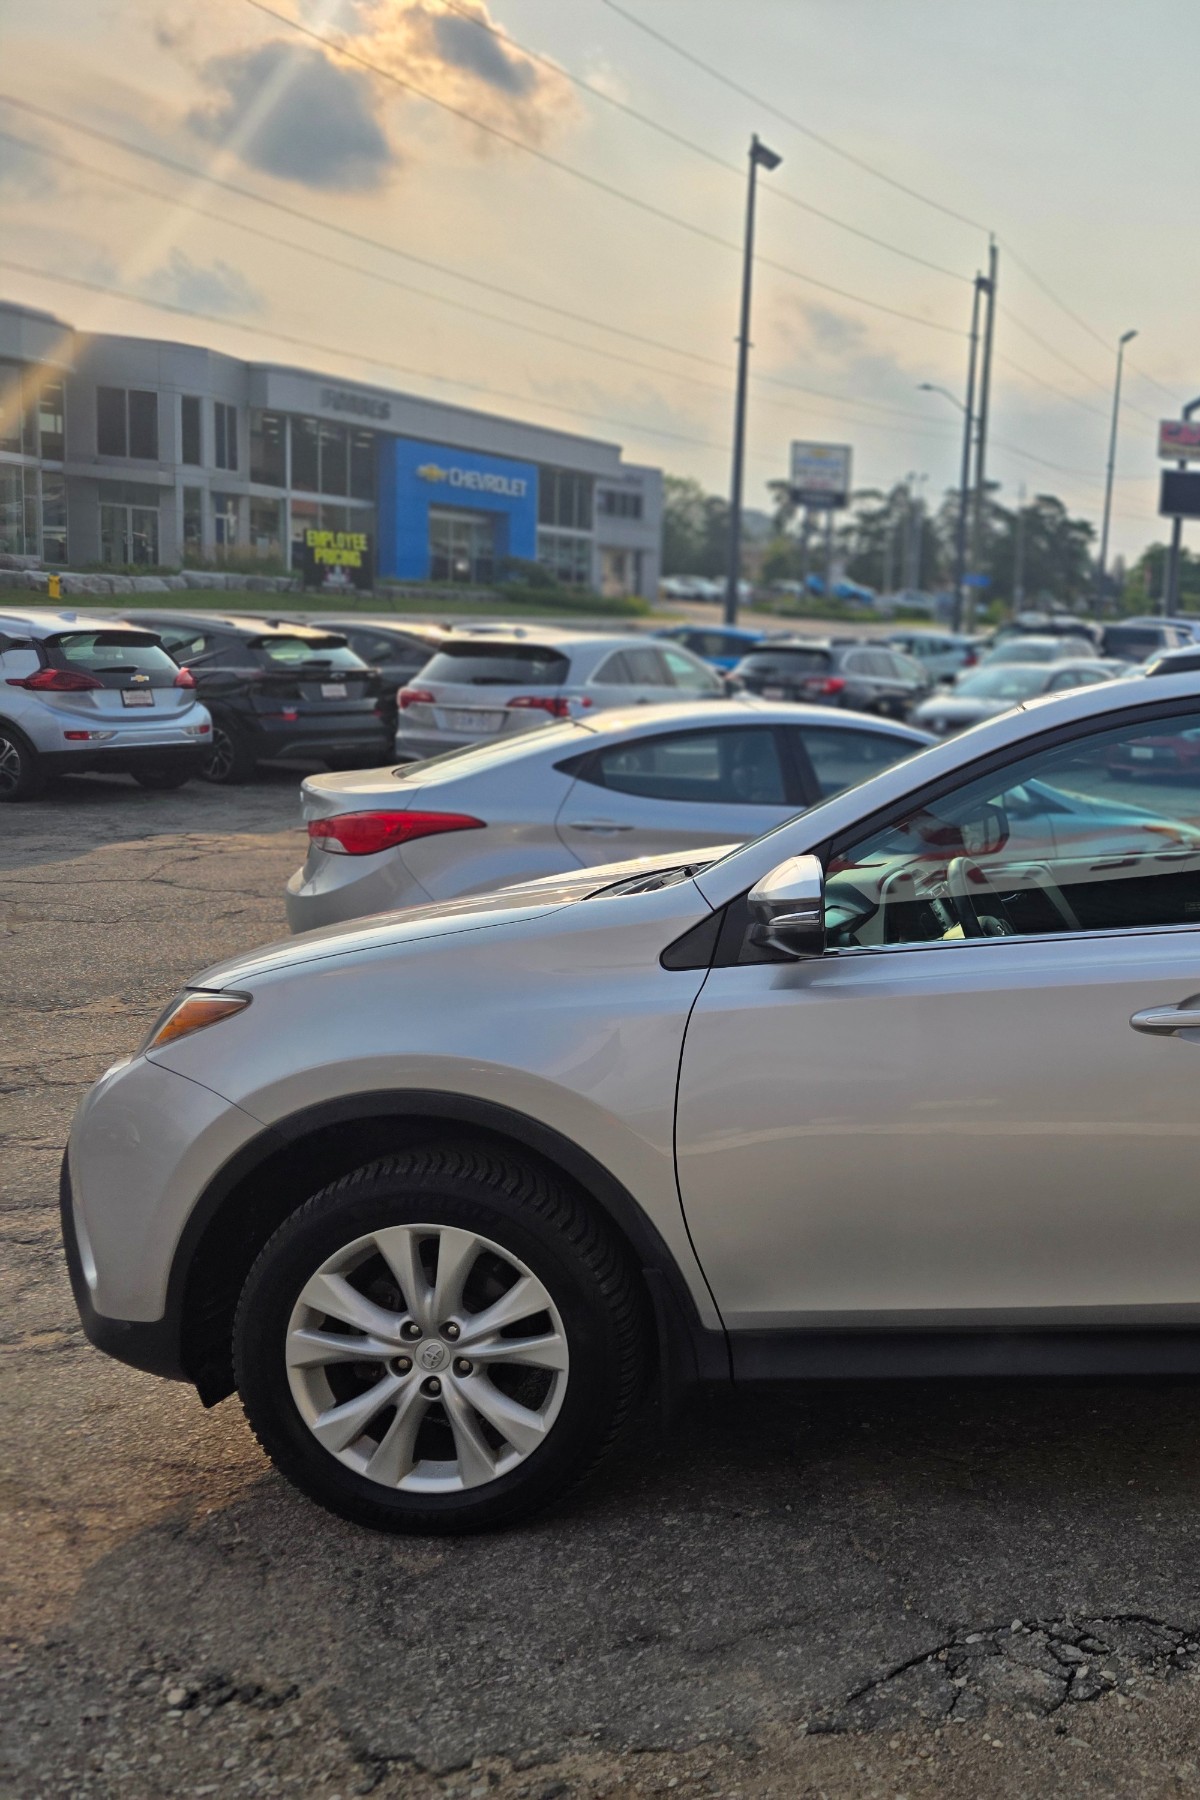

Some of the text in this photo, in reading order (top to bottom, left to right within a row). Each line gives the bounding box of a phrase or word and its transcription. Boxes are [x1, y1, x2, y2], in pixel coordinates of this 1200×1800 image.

[448, 467, 527, 497] CHEVROLET
[306, 529, 368, 551] EMPLOYEE
[314, 548, 362, 568] PRICING
